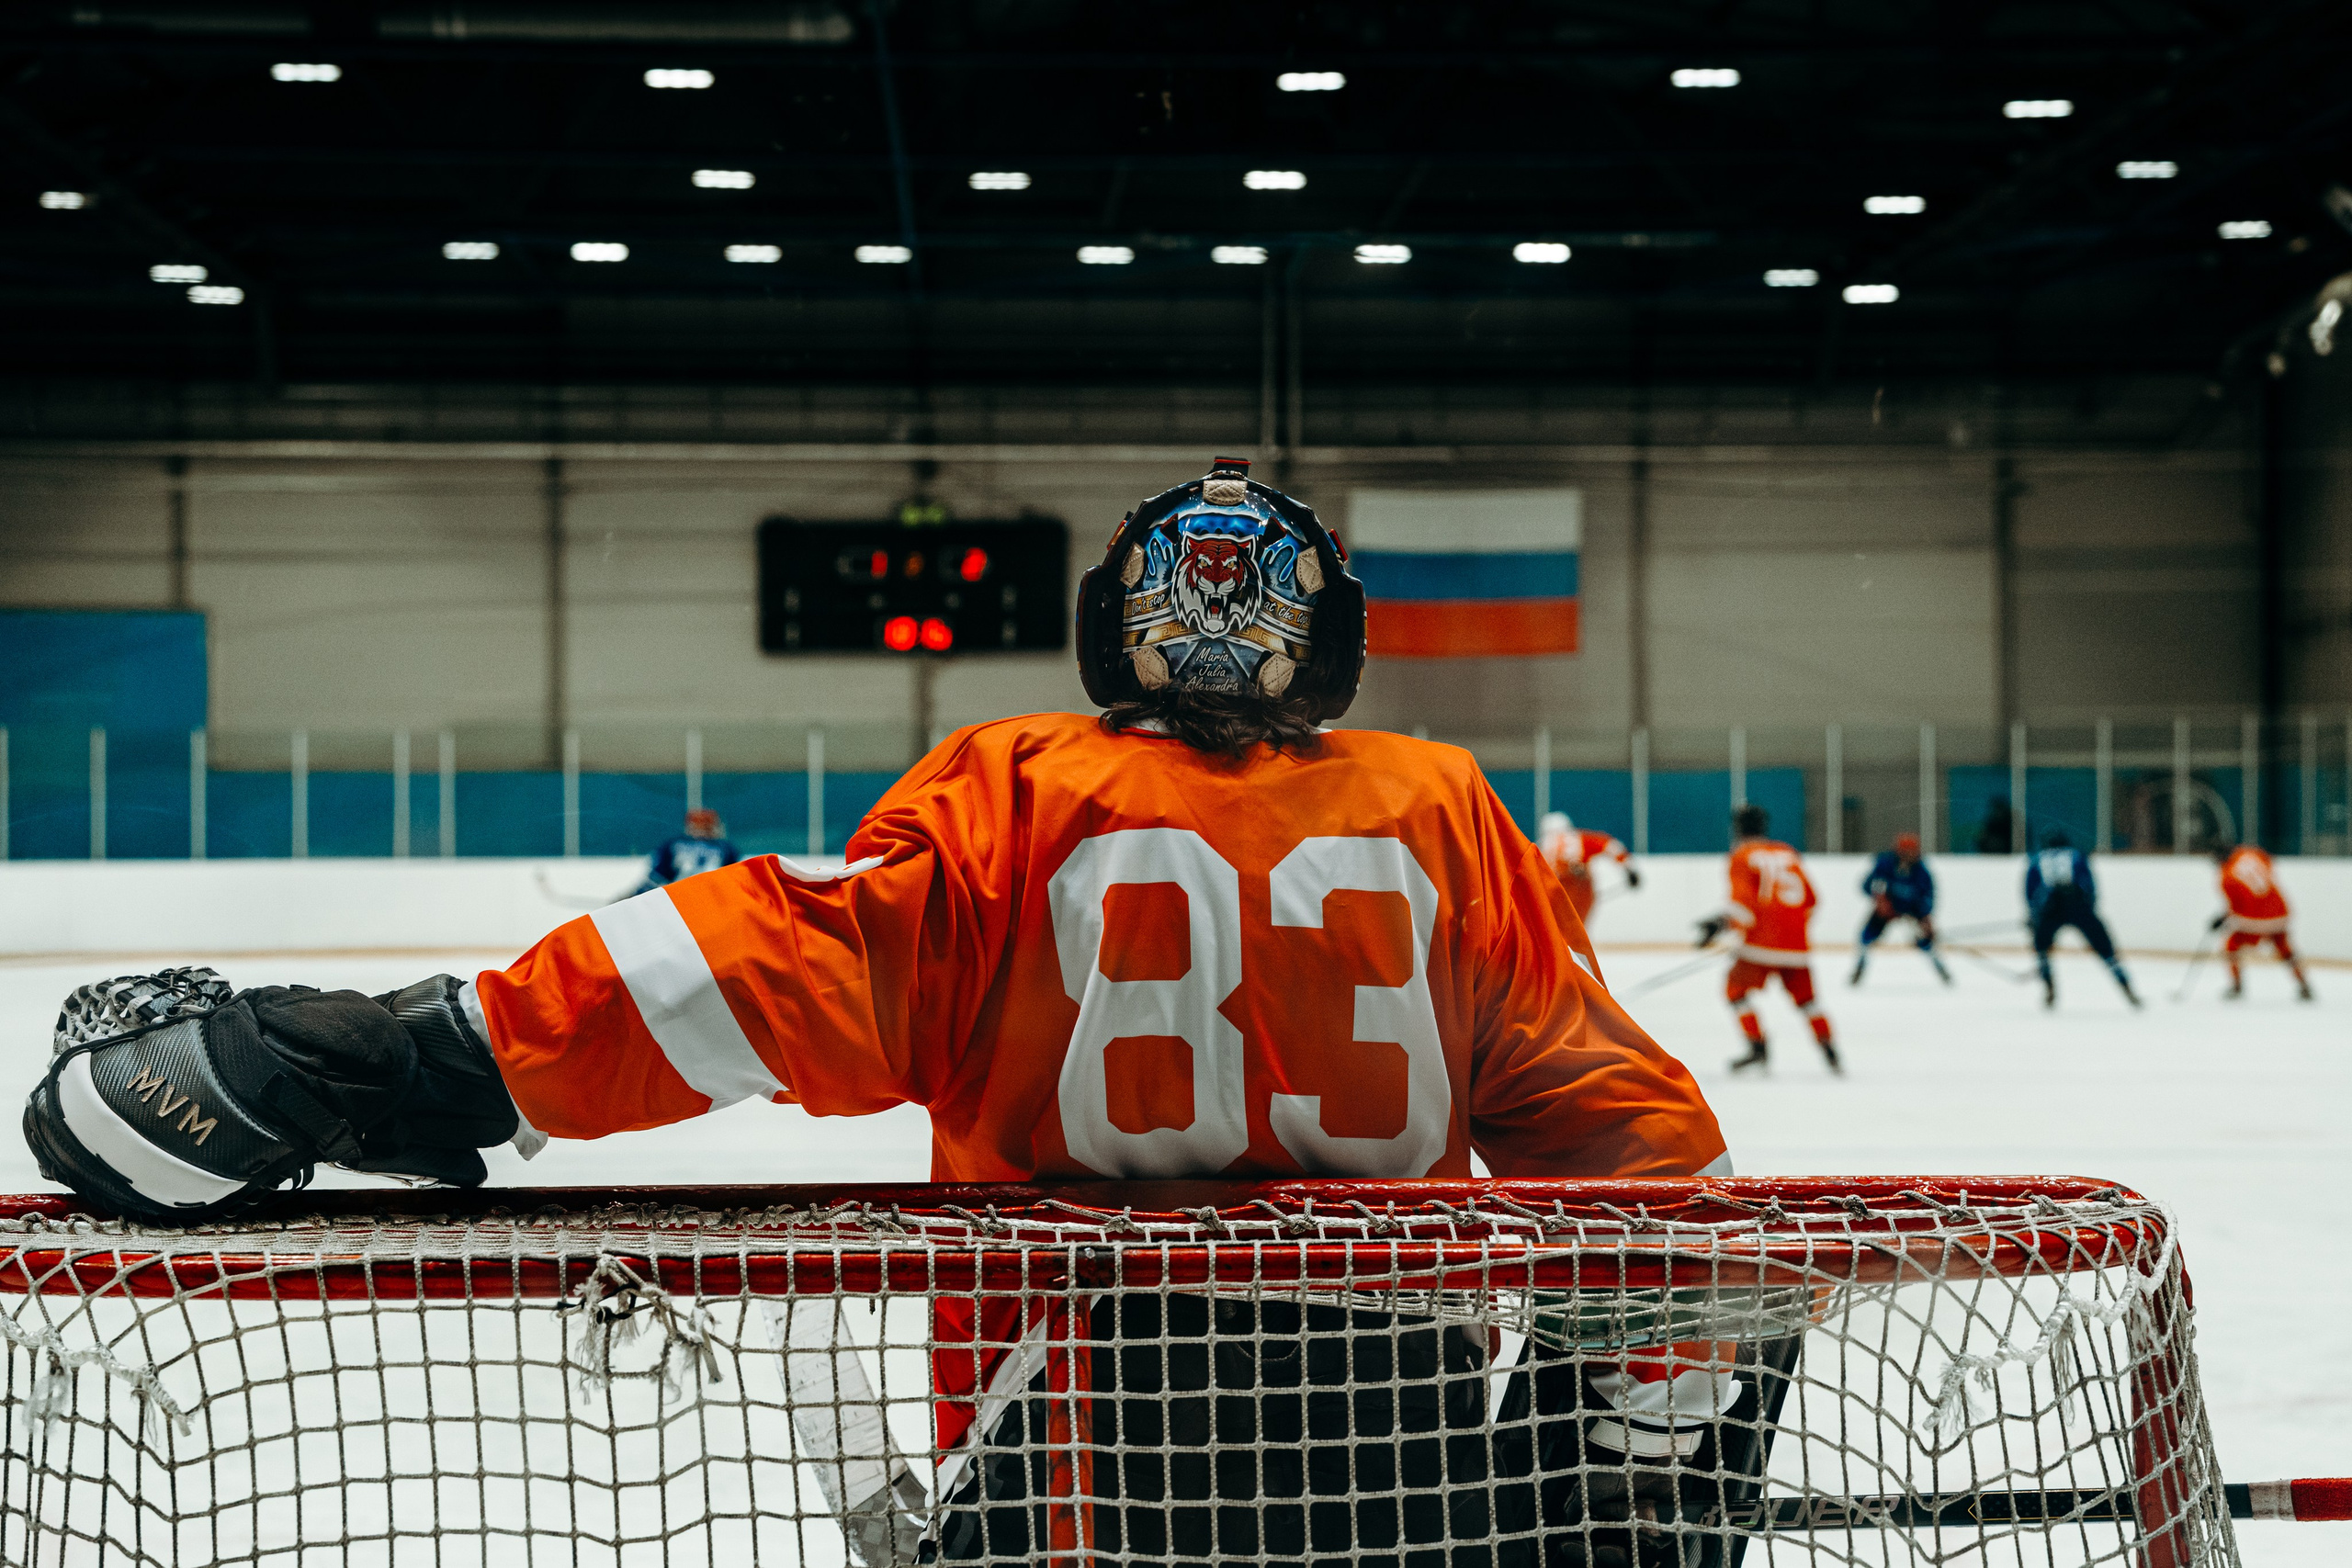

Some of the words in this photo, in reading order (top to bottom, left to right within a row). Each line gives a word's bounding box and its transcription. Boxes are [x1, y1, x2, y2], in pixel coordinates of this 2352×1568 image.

[1131, 596, 1147, 615] Don't
[1148, 593, 1165, 608] stop
[1263, 601, 1277, 612] at
[1278, 606, 1295, 620] the
[1296, 612, 1309, 628] top
[1195, 647, 1229, 662] Maria
[1198, 663, 1226, 677] Julia
[1184, 675, 1238, 692] Alexandra
[1747, 849, 1806, 908] 75
[1047, 828, 1452, 1179] 83
[126, 1065, 219, 1146] MVM
